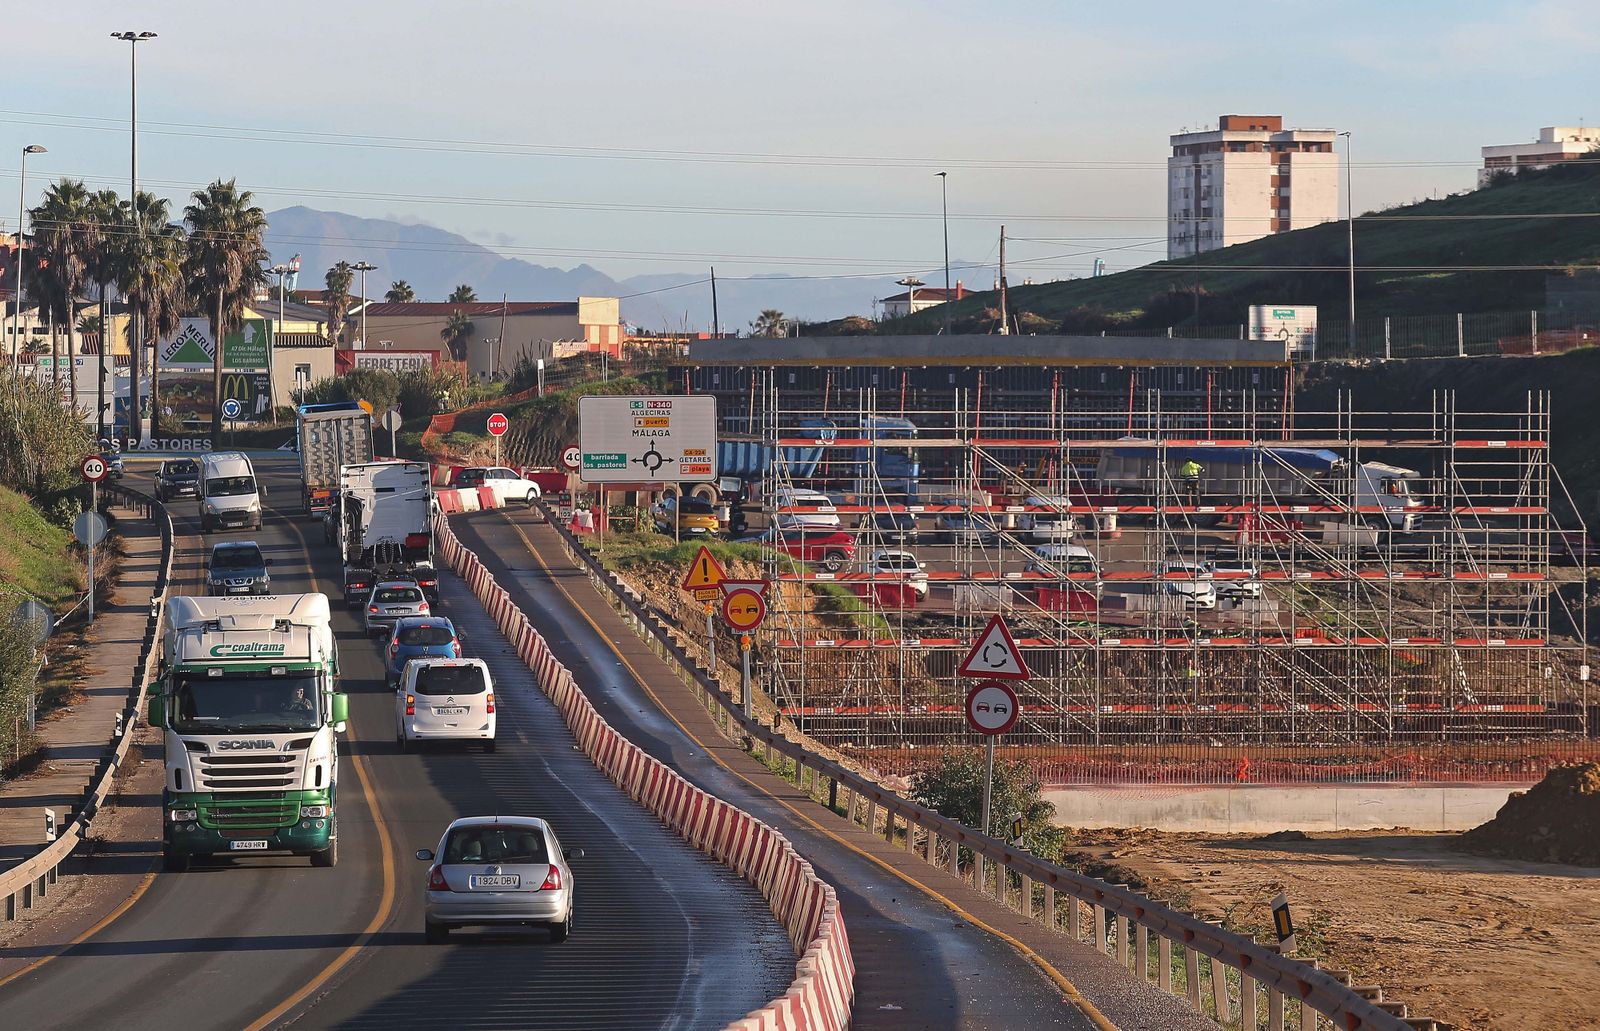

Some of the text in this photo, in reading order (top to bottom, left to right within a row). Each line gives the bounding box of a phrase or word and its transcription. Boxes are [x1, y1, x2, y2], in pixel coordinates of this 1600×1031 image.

[161, 330, 189, 361] LEROY
[632, 428, 671, 437] MÁLAGA
[127, 438, 213, 451] PASTORES
[86, 464, 102, 473] 40
[232, 642, 285, 651] coaltrama
[218, 740, 275, 750] SCANIA
[478, 877, 498, 885] 1924
[501, 877, 517, 885] DBV
